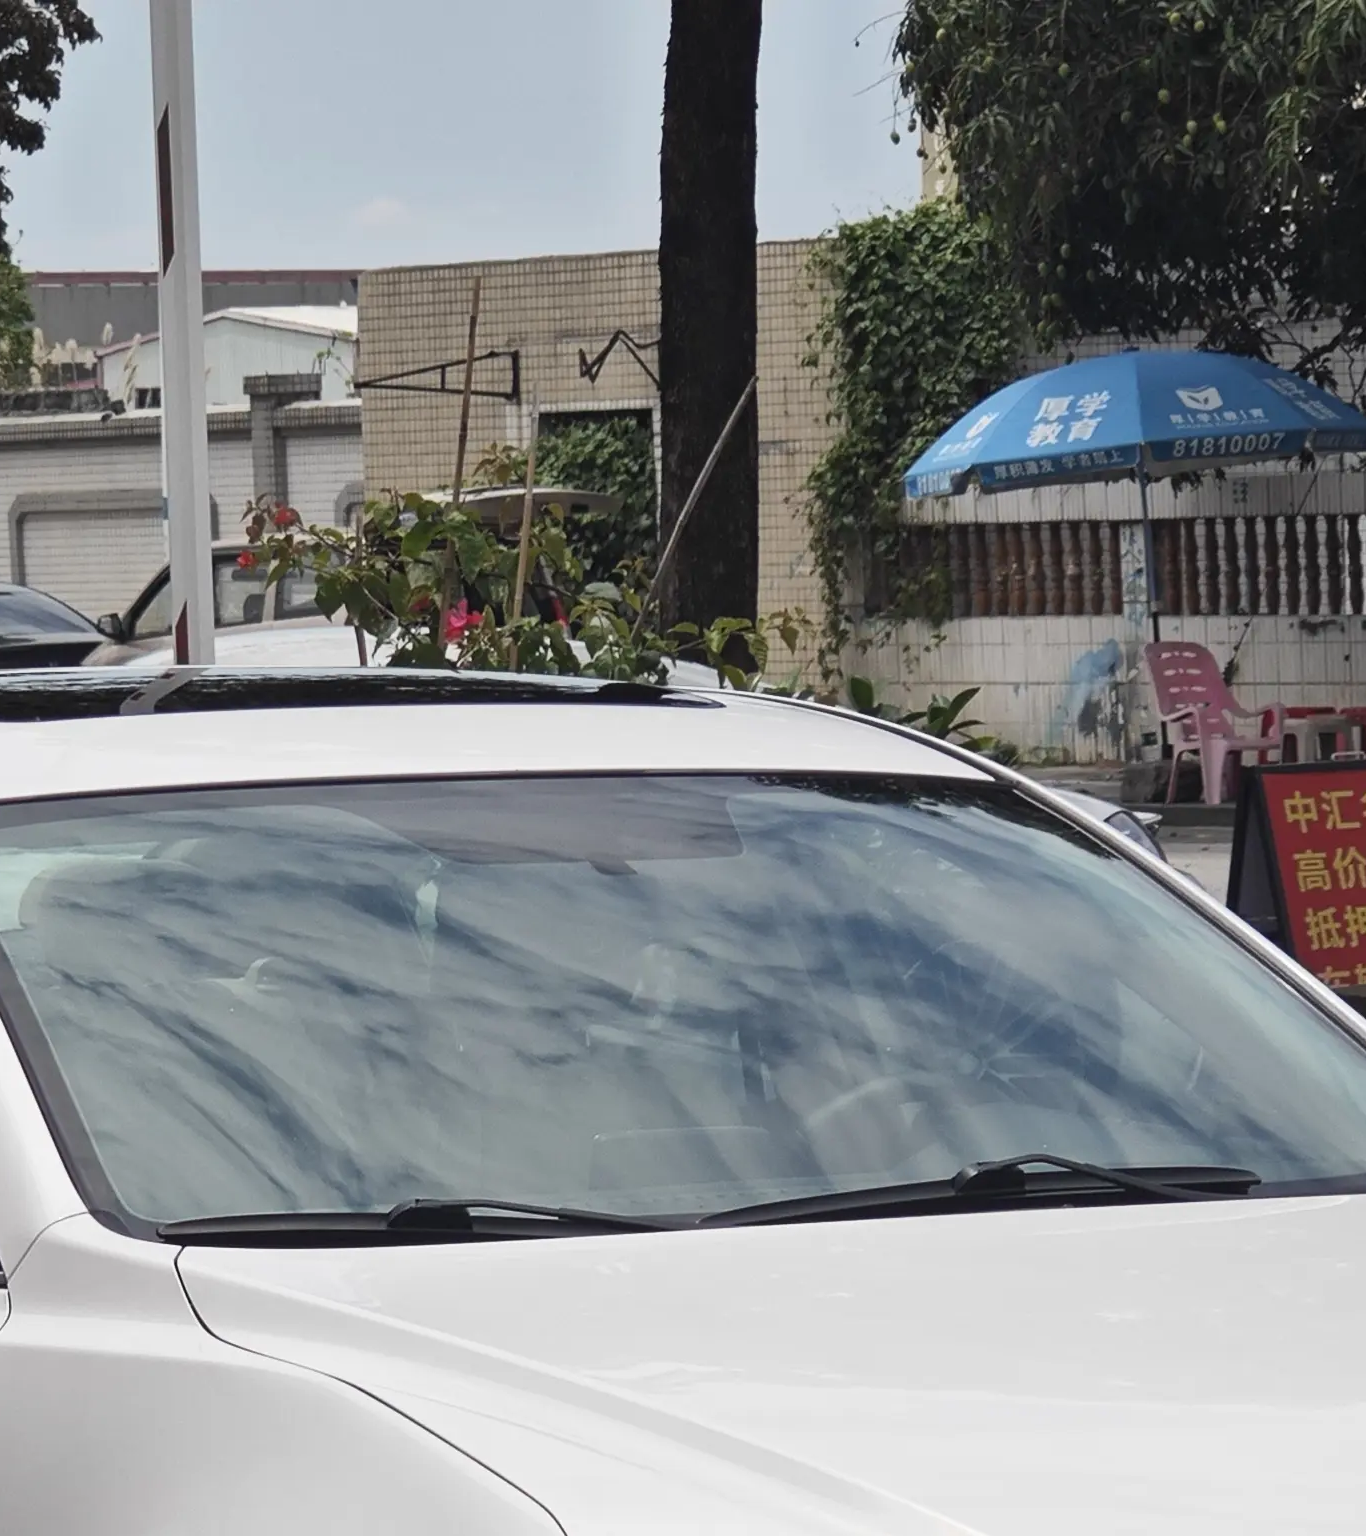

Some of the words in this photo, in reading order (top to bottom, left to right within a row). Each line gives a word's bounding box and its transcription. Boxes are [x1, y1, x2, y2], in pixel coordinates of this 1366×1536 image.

[1035, 390, 1111, 421] 厚学
[1026, 417, 1102, 448] 教育
[1173, 432, 1286, 457] 81810007
